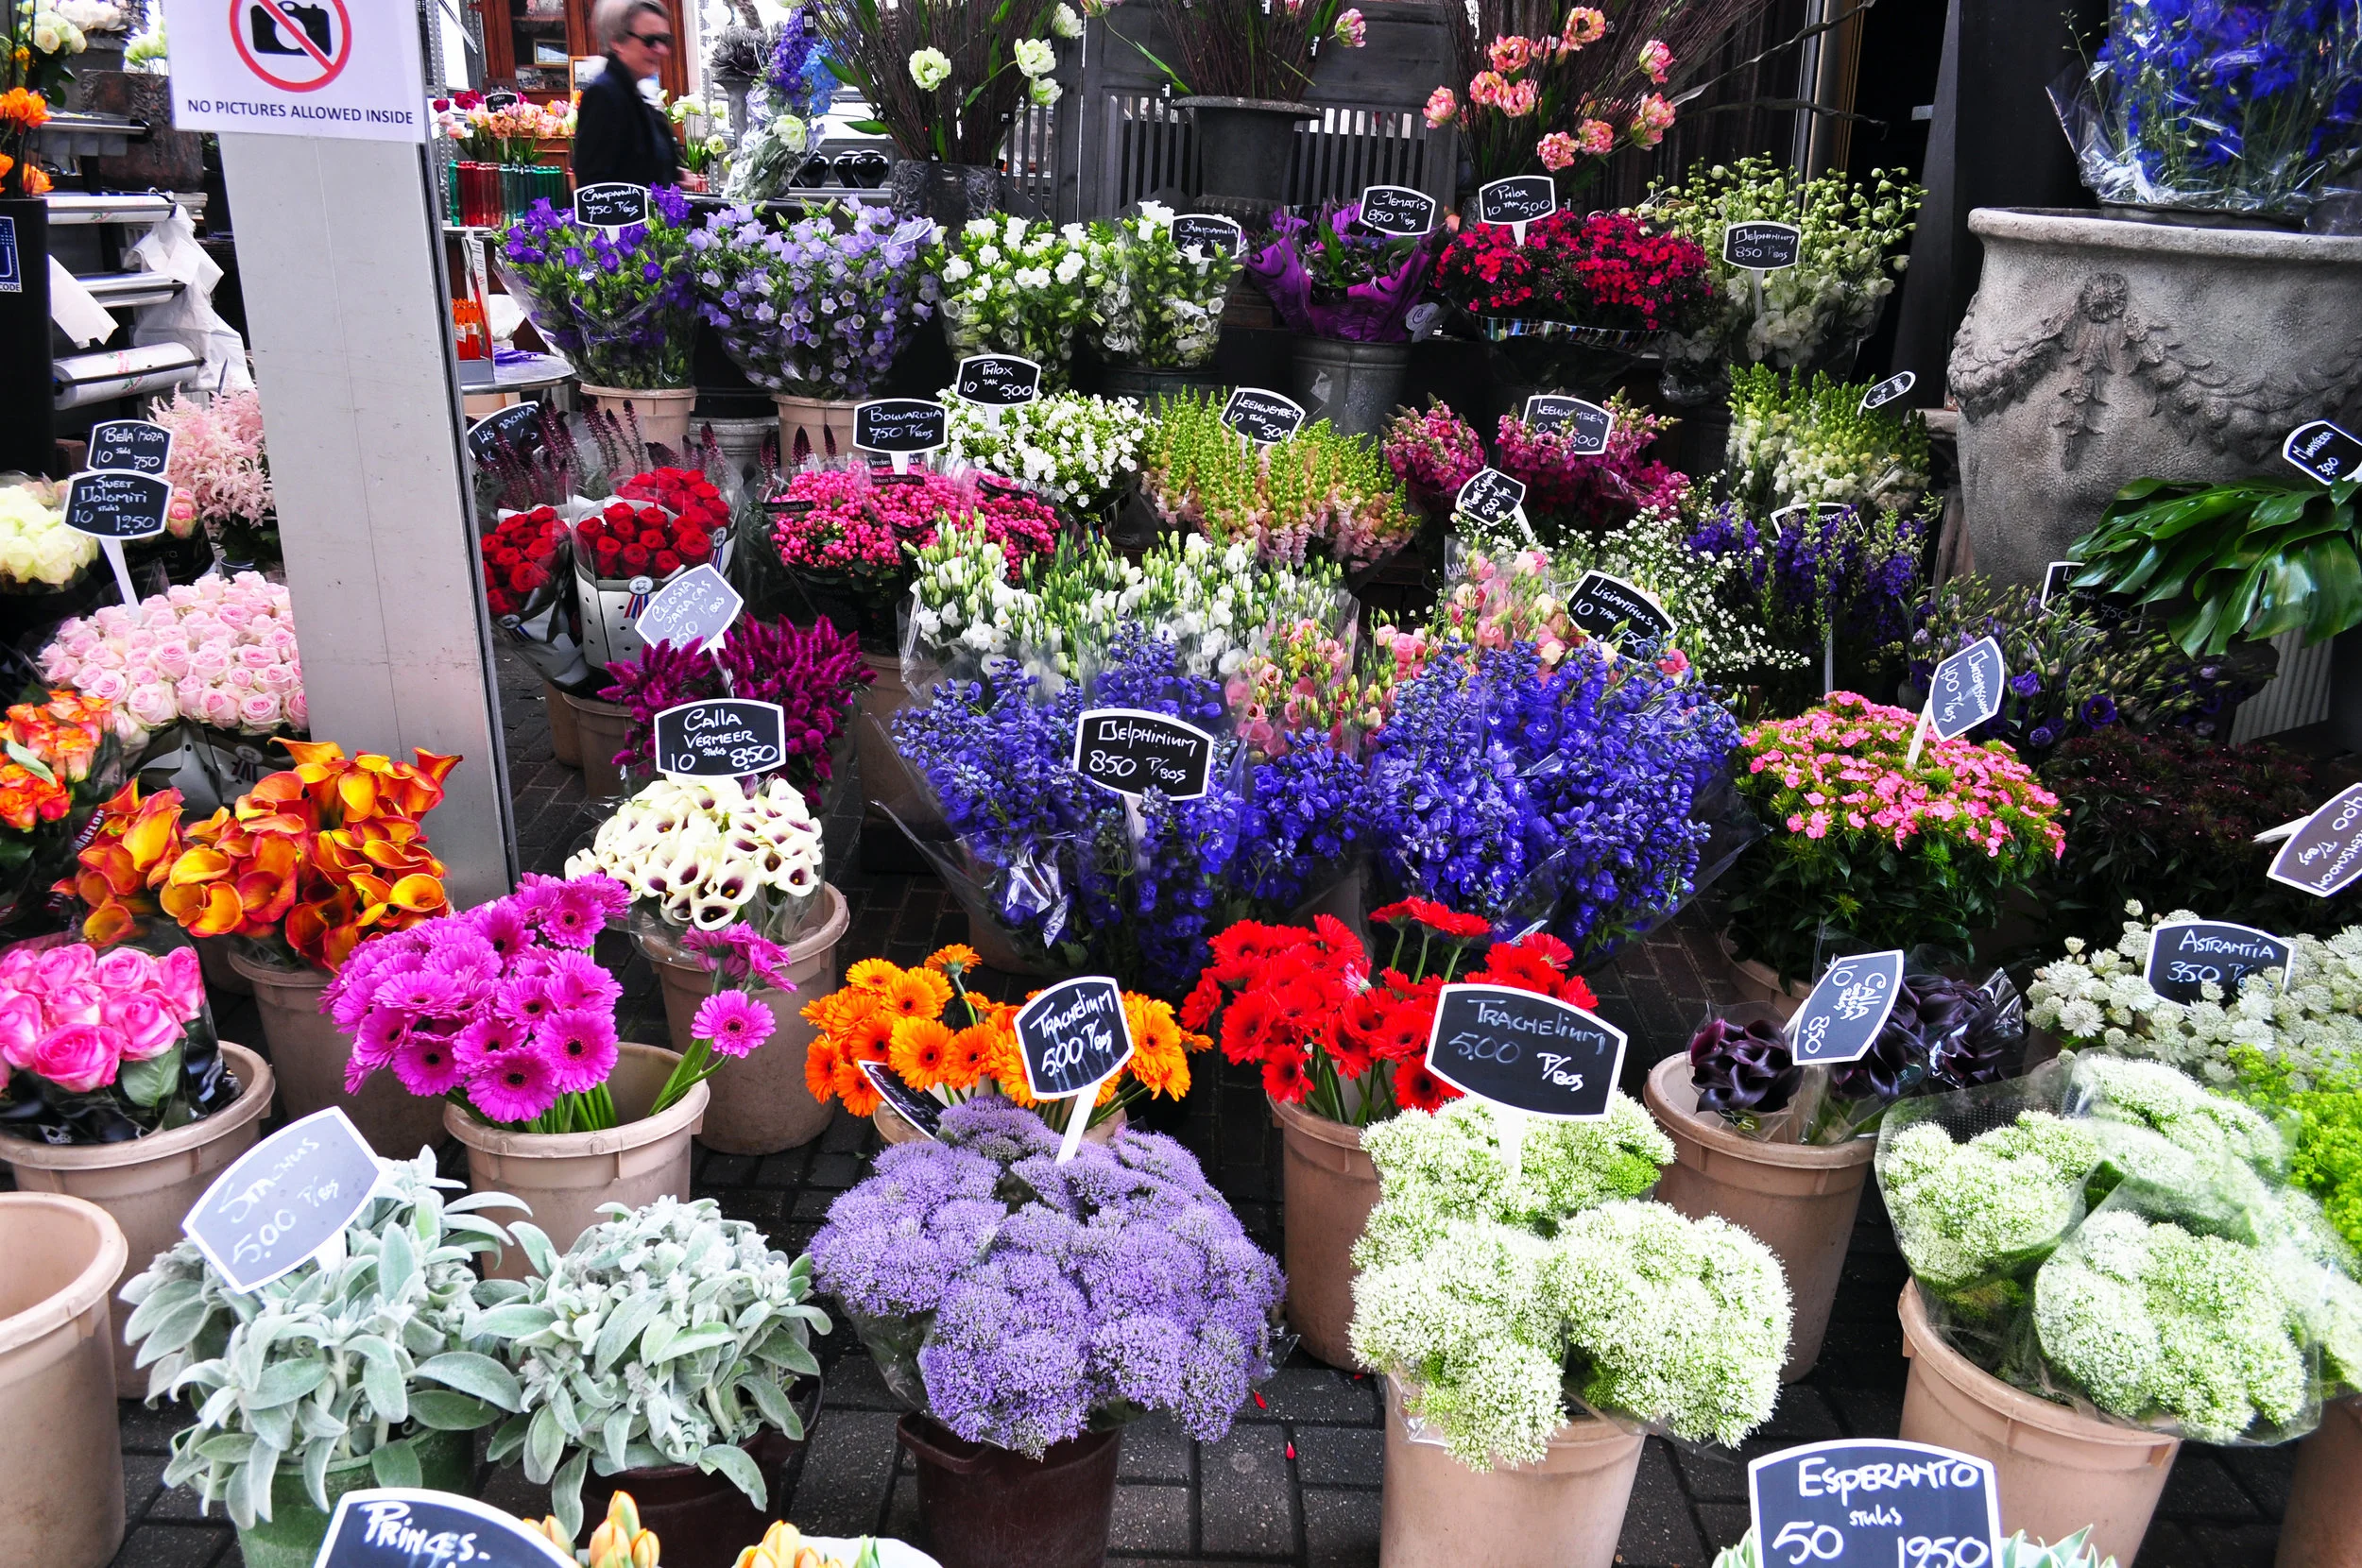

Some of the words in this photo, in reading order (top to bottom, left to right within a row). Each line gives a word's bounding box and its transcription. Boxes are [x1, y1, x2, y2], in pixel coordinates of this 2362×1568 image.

[188, 99, 211, 112] NO
[216, 101, 285, 117] PICTURES
[291, 105, 361, 121] ALLOWED
[367, 110, 413, 125] INSIDE
[1486, 205, 1501, 217] 10
[963, 381, 978, 393] 10
[1572, 598, 1595, 616] 10
[683, 730, 759, 749] VERMEER
[671, 753, 696, 773] 10
[1772, 1520, 1845, 1565] 50
